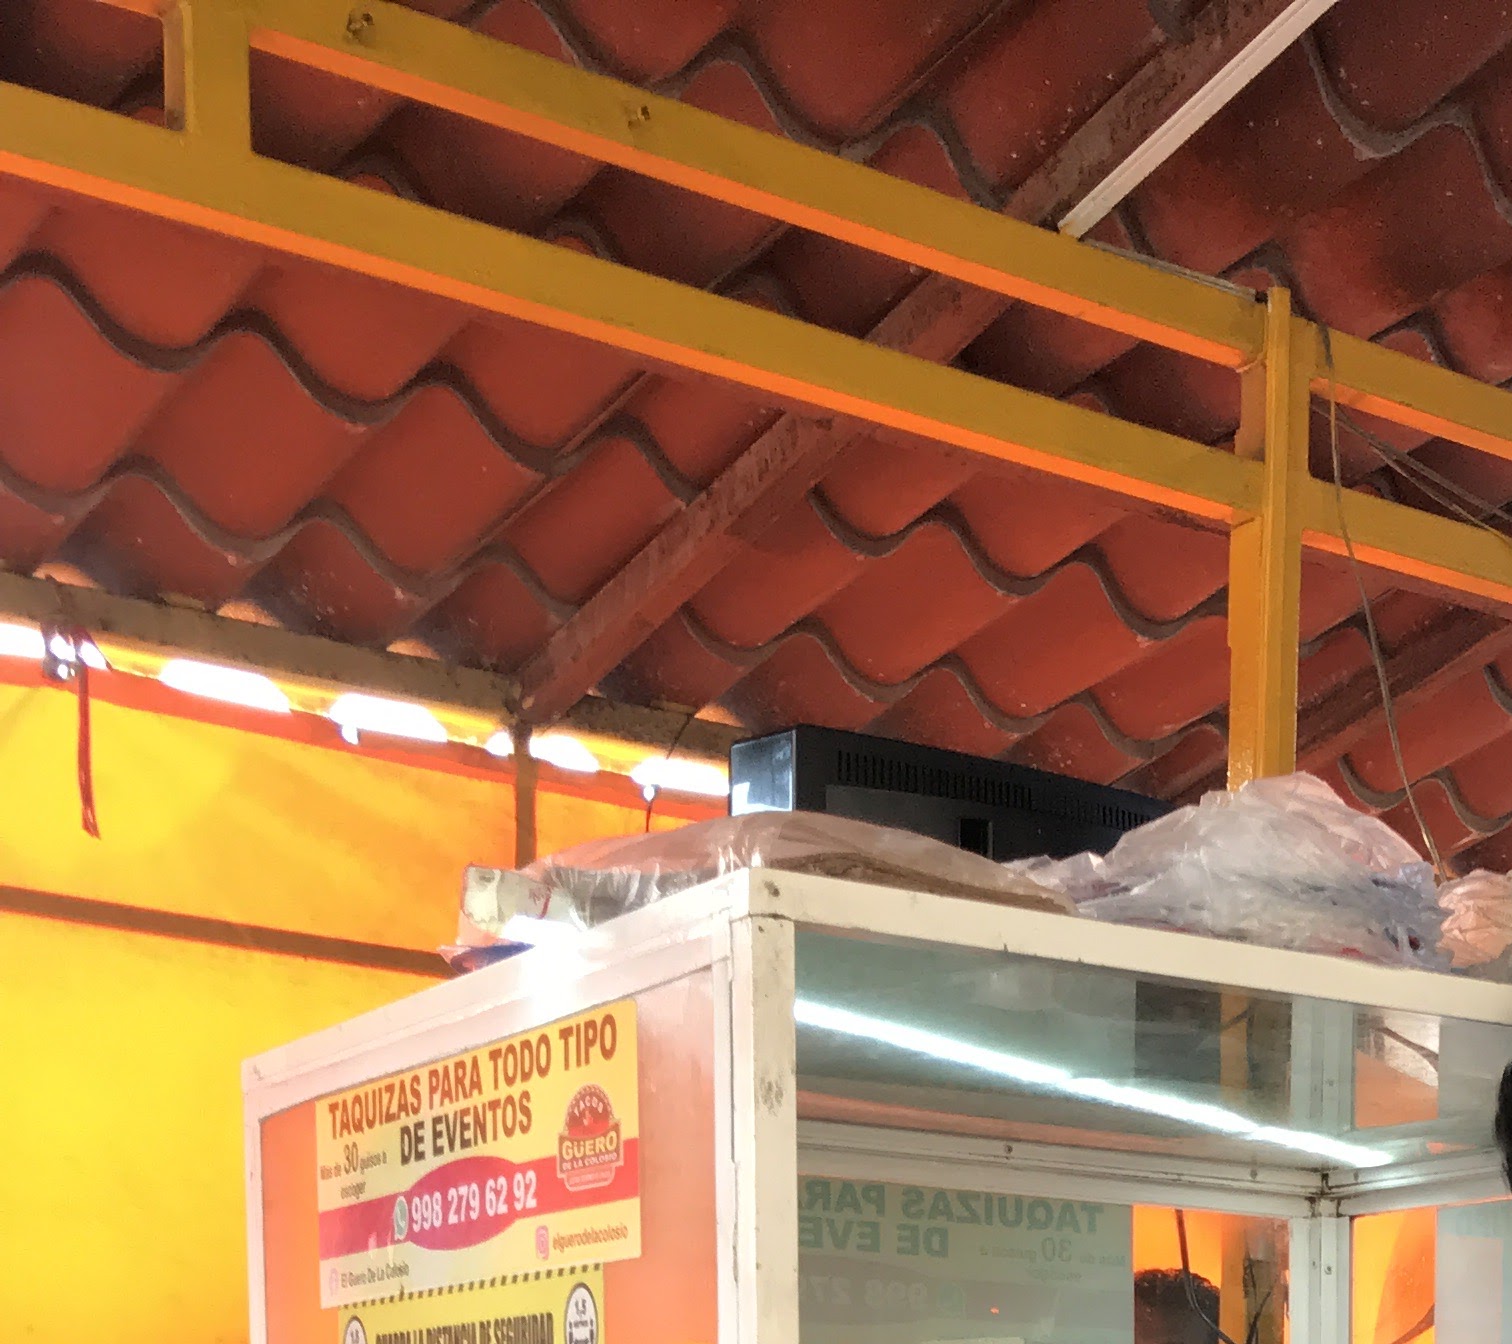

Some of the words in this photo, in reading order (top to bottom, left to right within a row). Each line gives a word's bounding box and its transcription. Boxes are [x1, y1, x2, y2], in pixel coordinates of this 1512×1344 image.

[328, 1073, 421, 1140] TAQUIZAS
[428, 1055, 483, 1111] PARA
[489, 1033, 552, 1090] TODO
[559, 1013, 617, 1072] TIPO
[343, 1141, 359, 1174] 30
[401, 1122, 424, 1166] DE
[432, 1091, 533, 1157] EVENTOS
[562, 1131, 618, 1161] GÜERO
[411, 1193, 443, 1233] 998
[447, 1185, 480, 1227] 279
[484, 1176, 509, 1216] 62
[512, 1170, 538, 1210] 92
